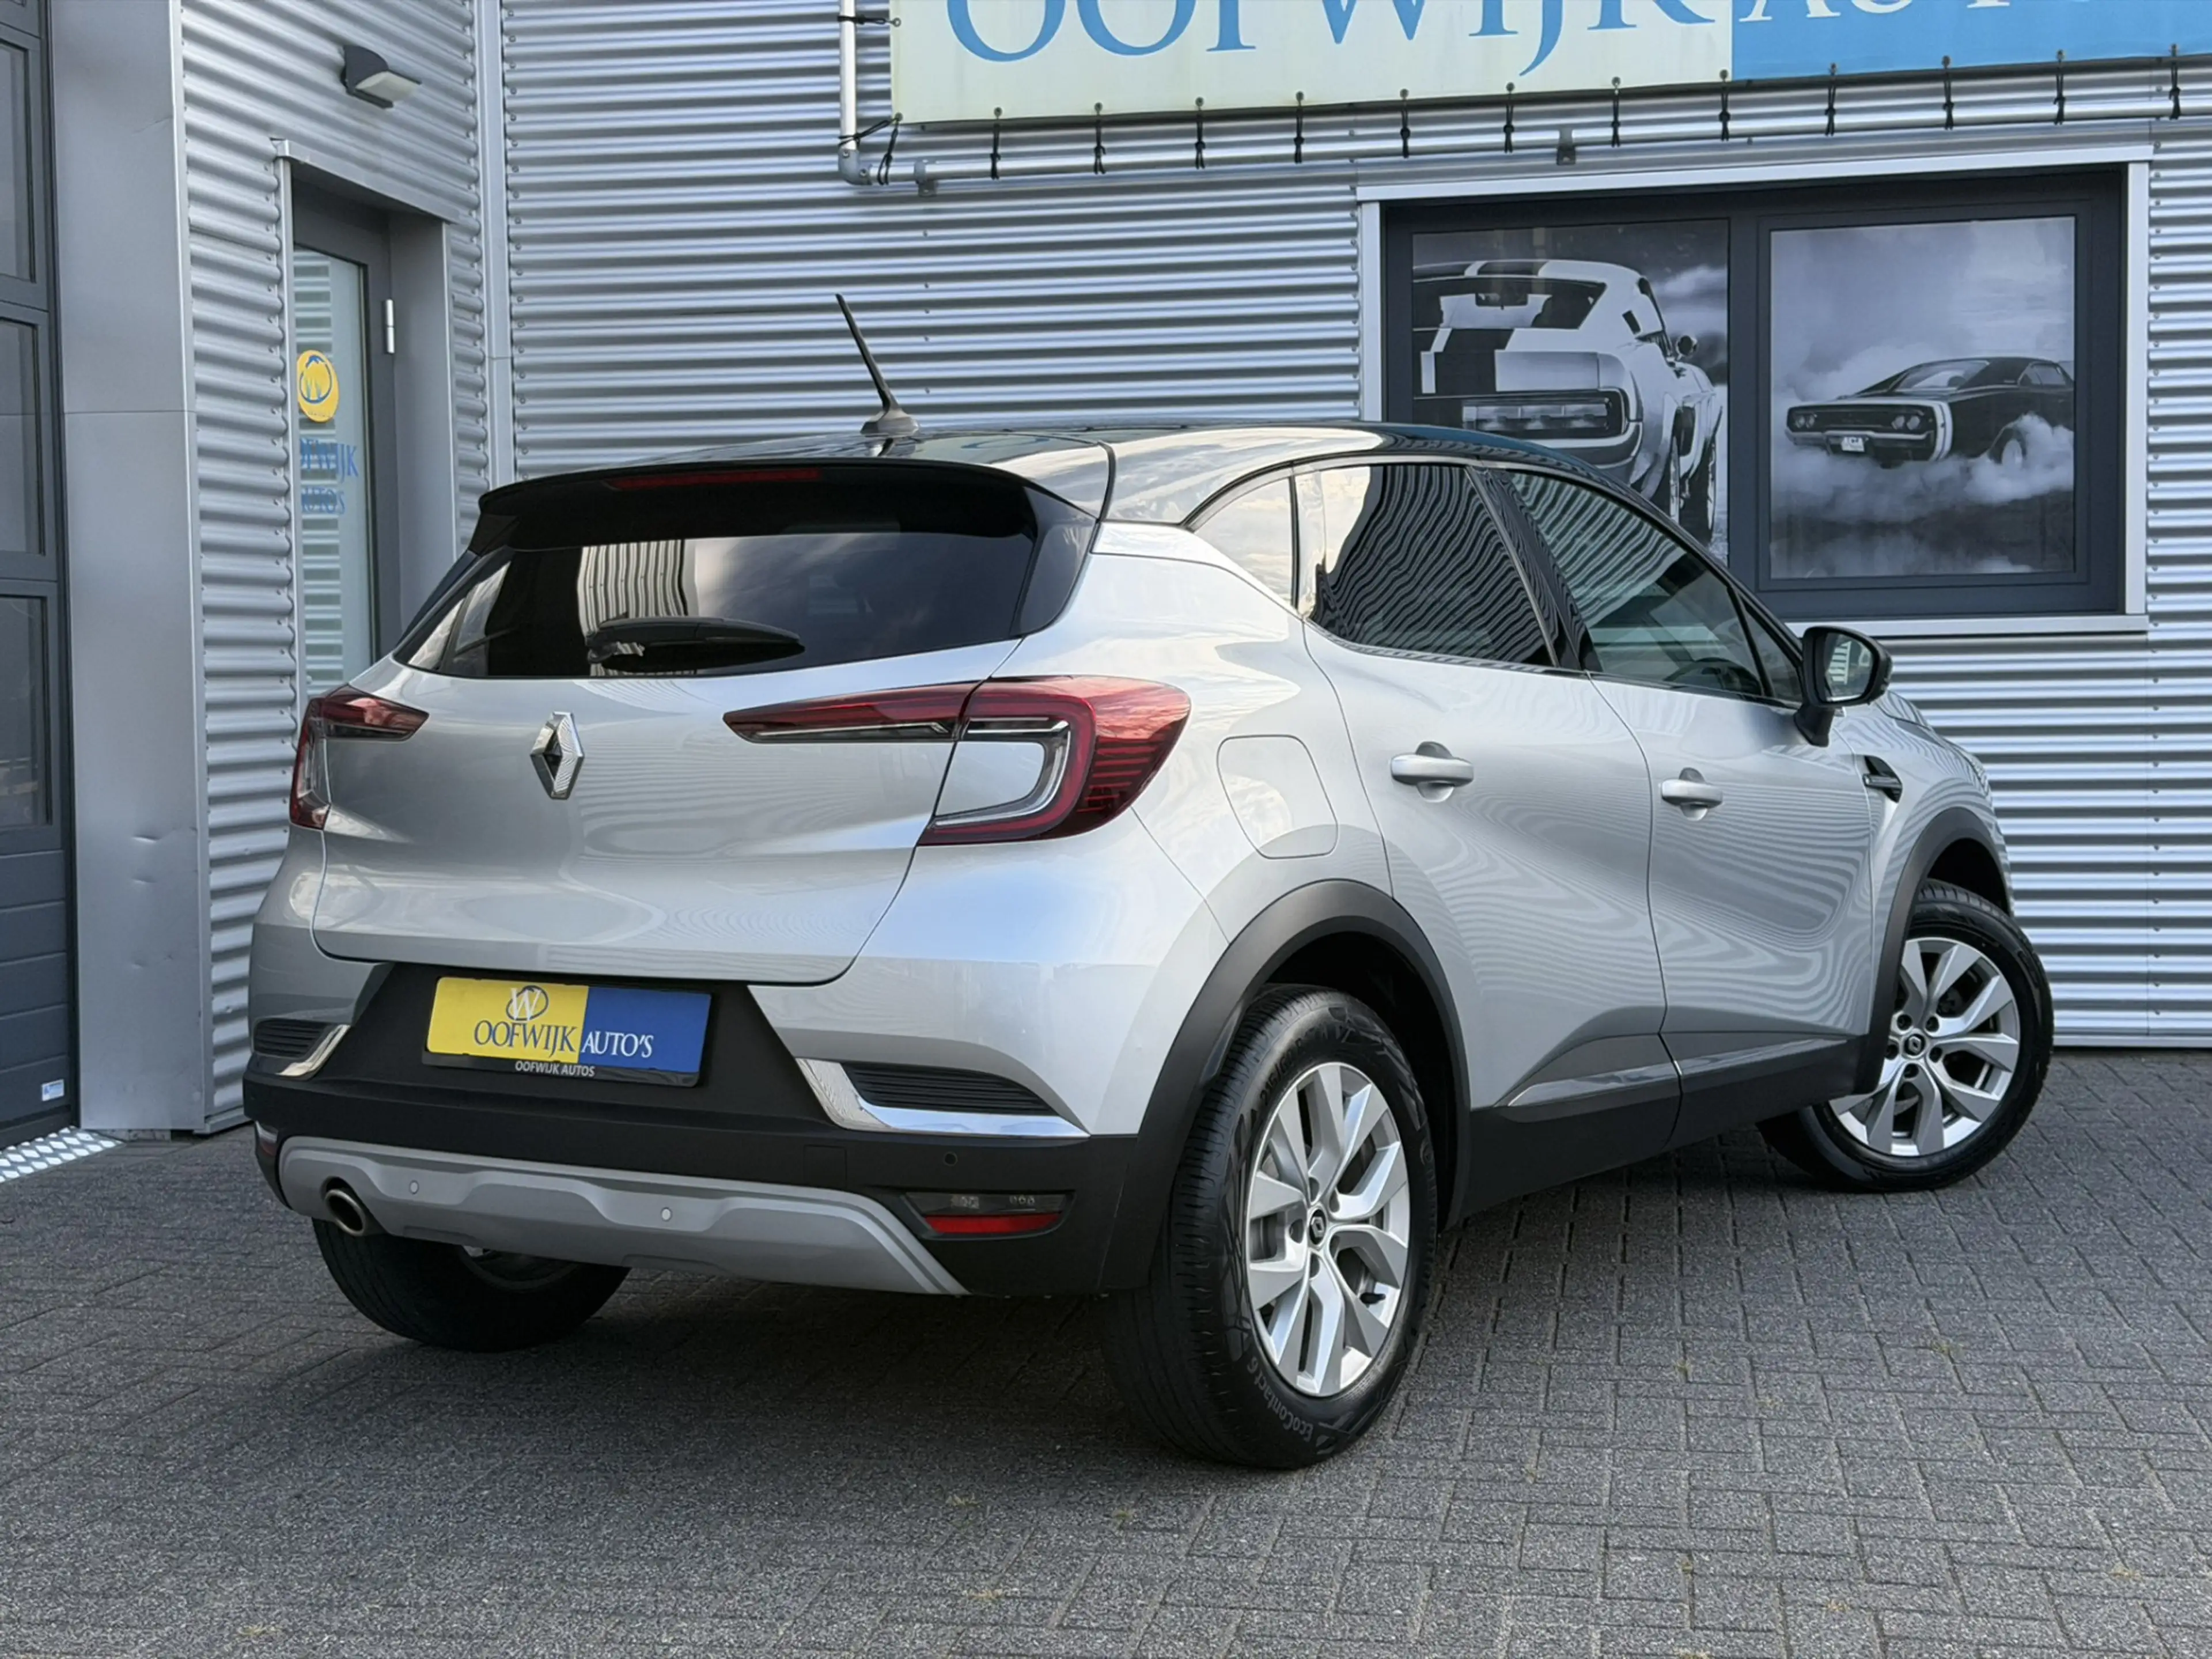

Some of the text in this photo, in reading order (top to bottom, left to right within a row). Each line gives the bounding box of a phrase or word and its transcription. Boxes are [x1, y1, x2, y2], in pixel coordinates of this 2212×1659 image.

[474, 1020, 654, 1059] OOFWIJK AUTO'S
[560, 1064, 596, 1078] AUTOS
